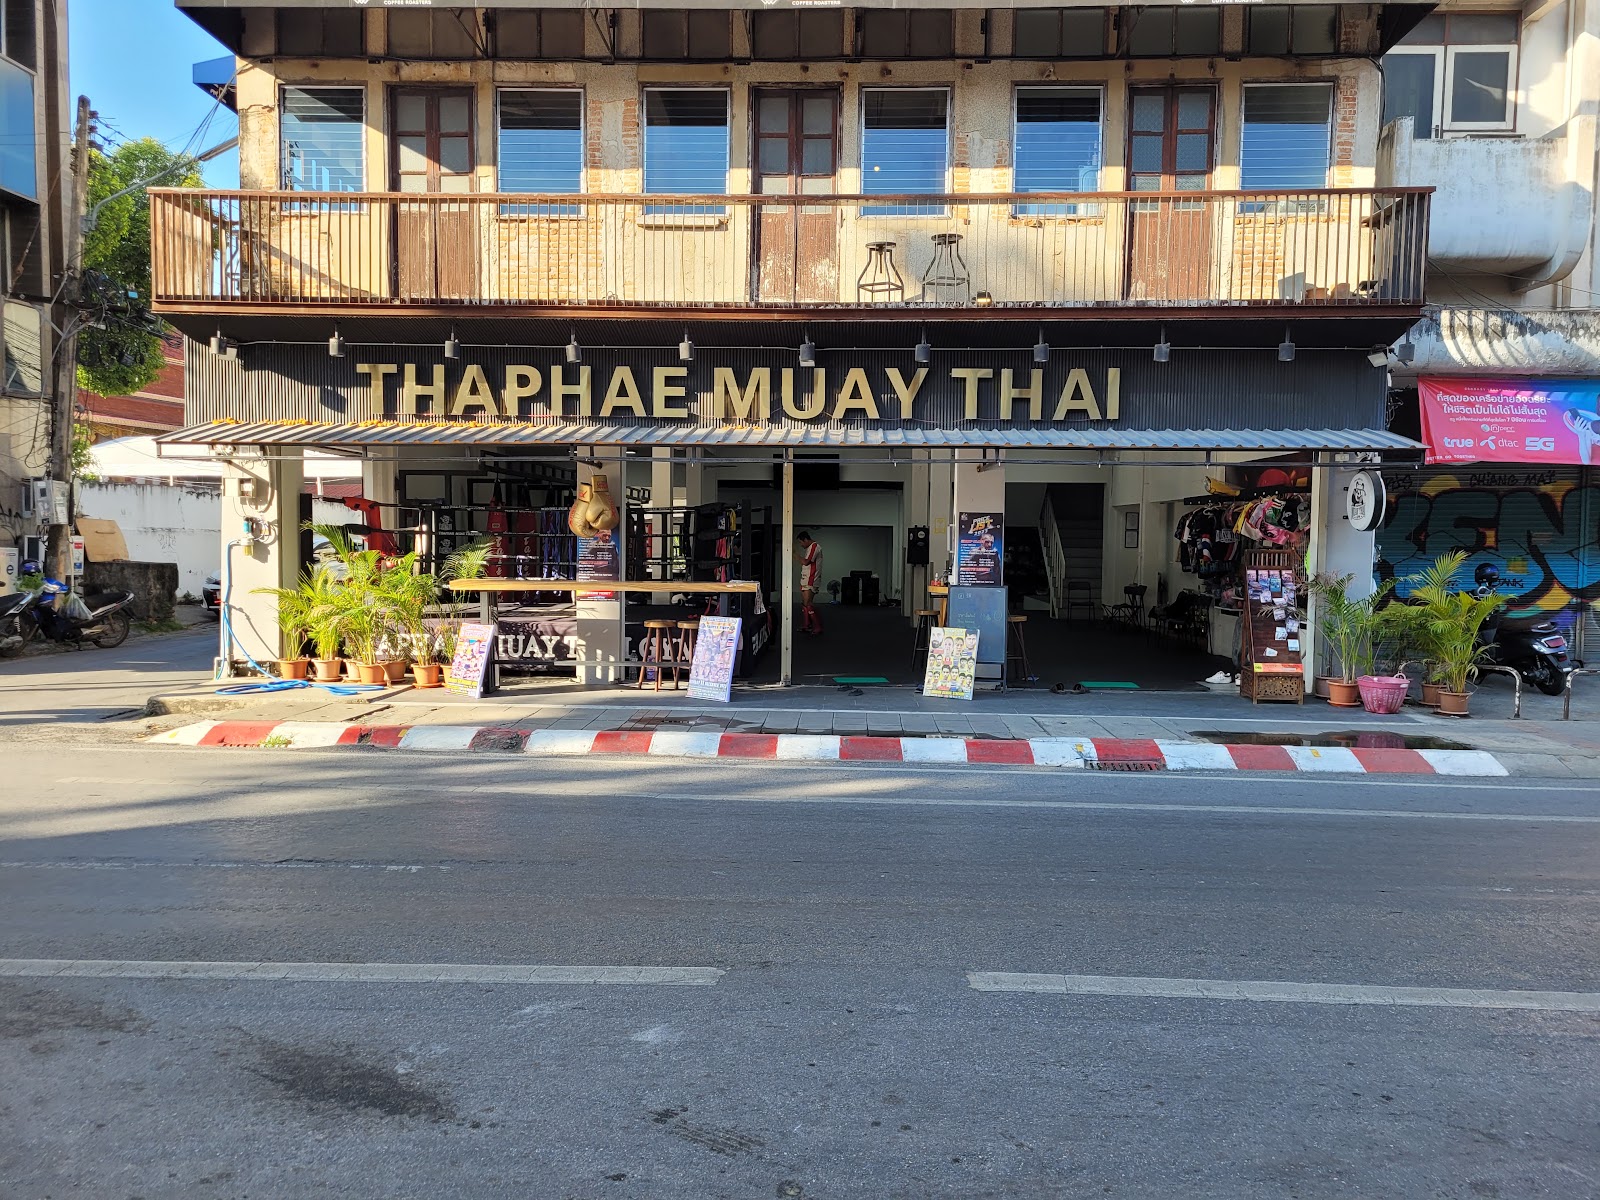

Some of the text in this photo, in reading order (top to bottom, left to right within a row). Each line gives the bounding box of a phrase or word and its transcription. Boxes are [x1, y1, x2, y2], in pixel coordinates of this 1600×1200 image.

[356, 363, 1121, 421] THAPHAE MUAY THAI
[1443, 437, 1555, 451] true dtac 5G
[972, 515, 991, 524] PRICE
